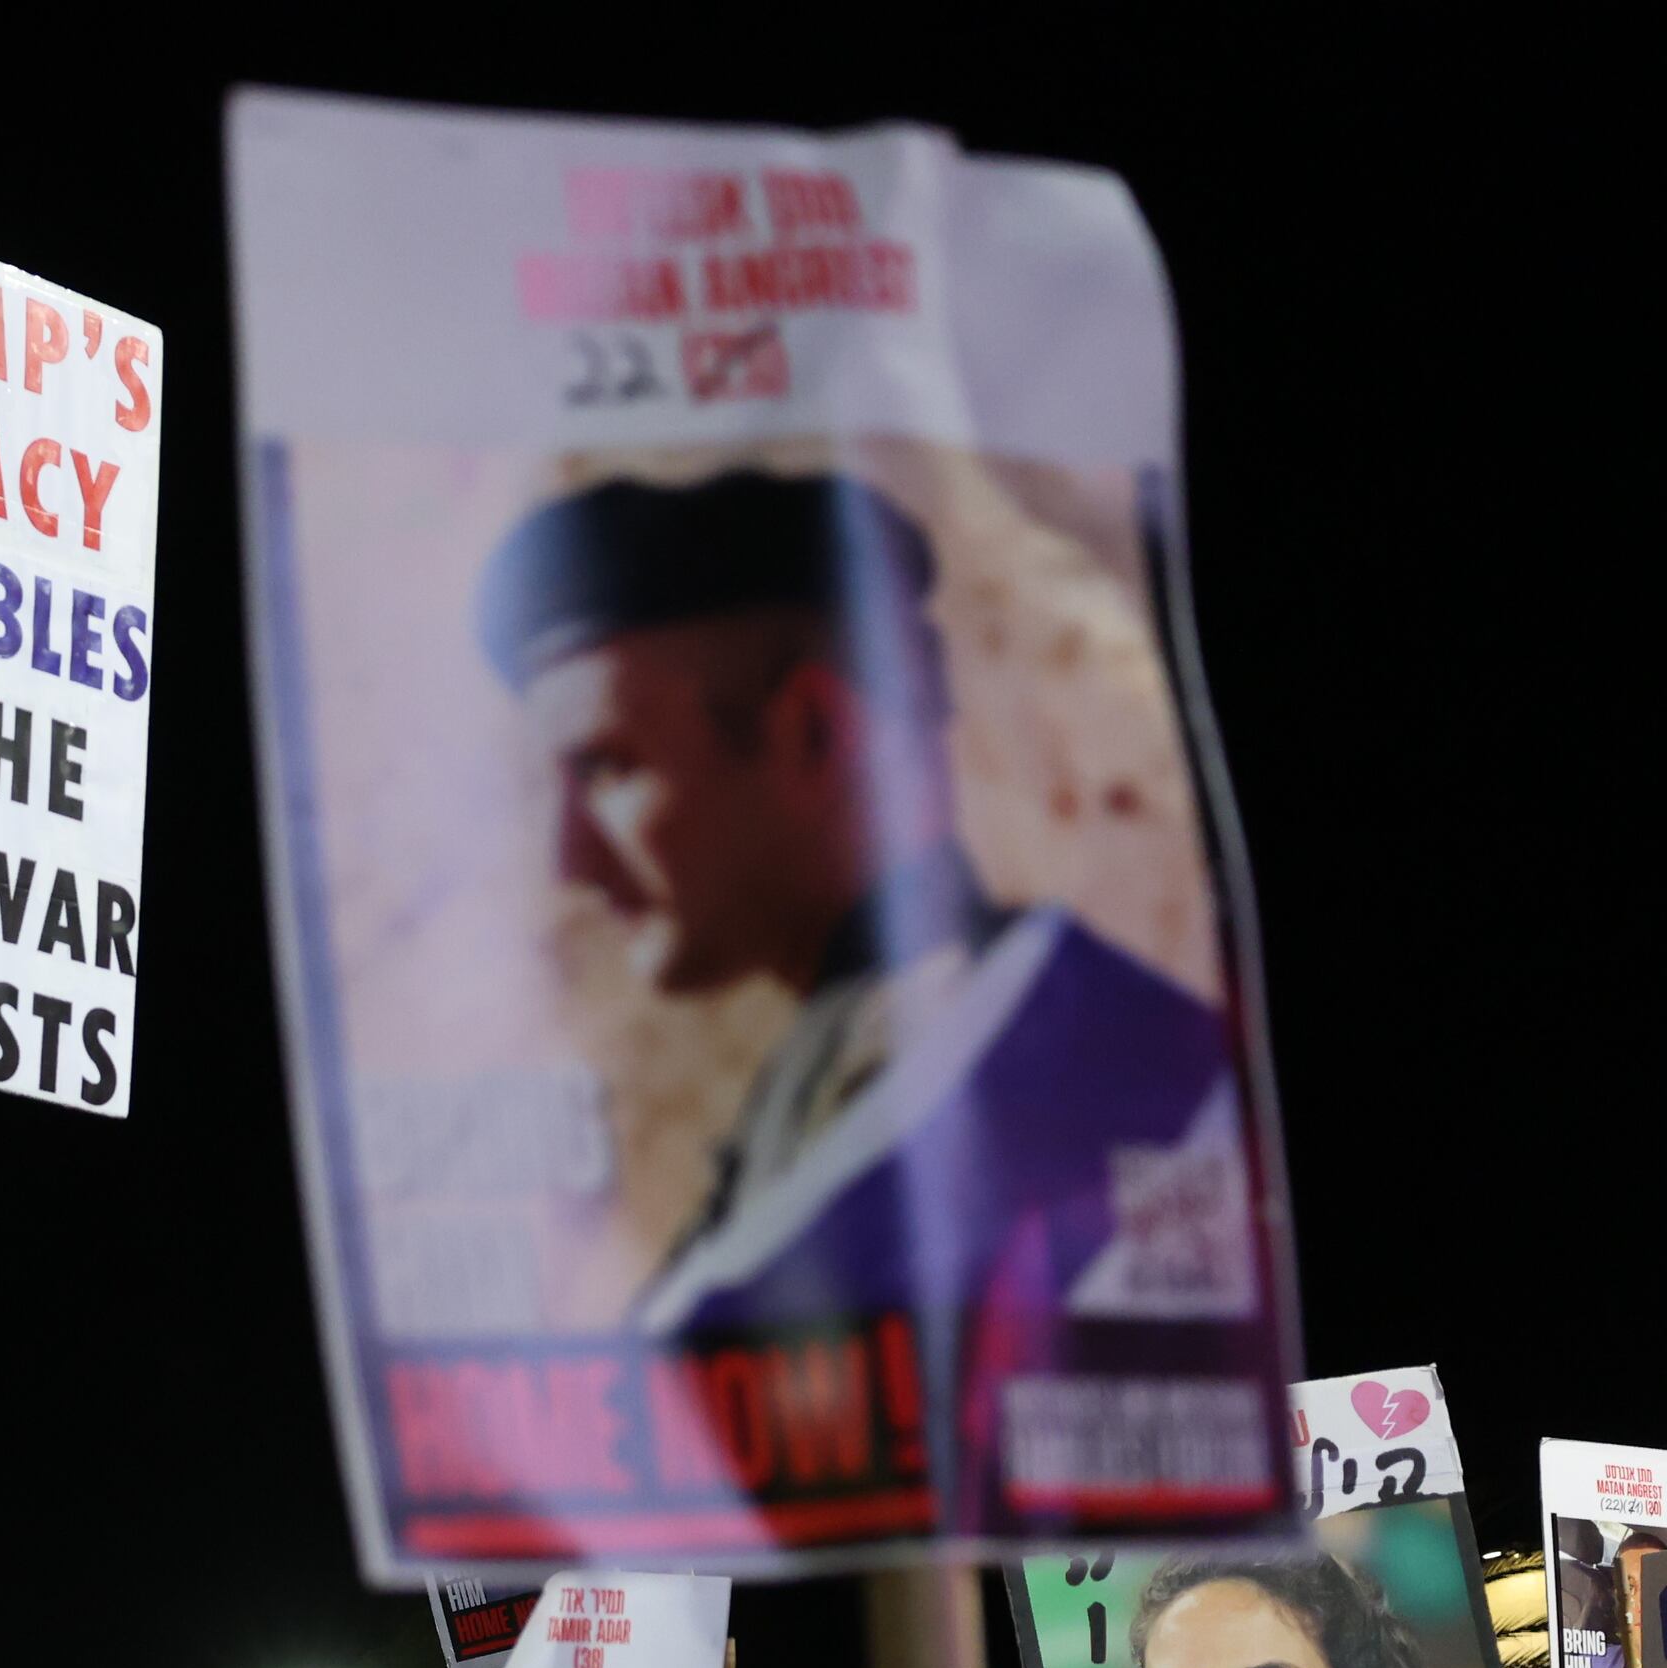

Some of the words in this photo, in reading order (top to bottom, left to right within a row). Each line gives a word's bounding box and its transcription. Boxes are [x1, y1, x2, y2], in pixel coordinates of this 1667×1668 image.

[1596, 1479, 1625, 1495] MATAN
[1627, 1483, 1662, 1499] ANGREST
[447, 1578, 487, 1612] HIM
[546, 1614, 593, 1644] TAMIR
[596, 1618, 631, 1646] ADAR
[1563, 1628, 1606, 1656] BRING
